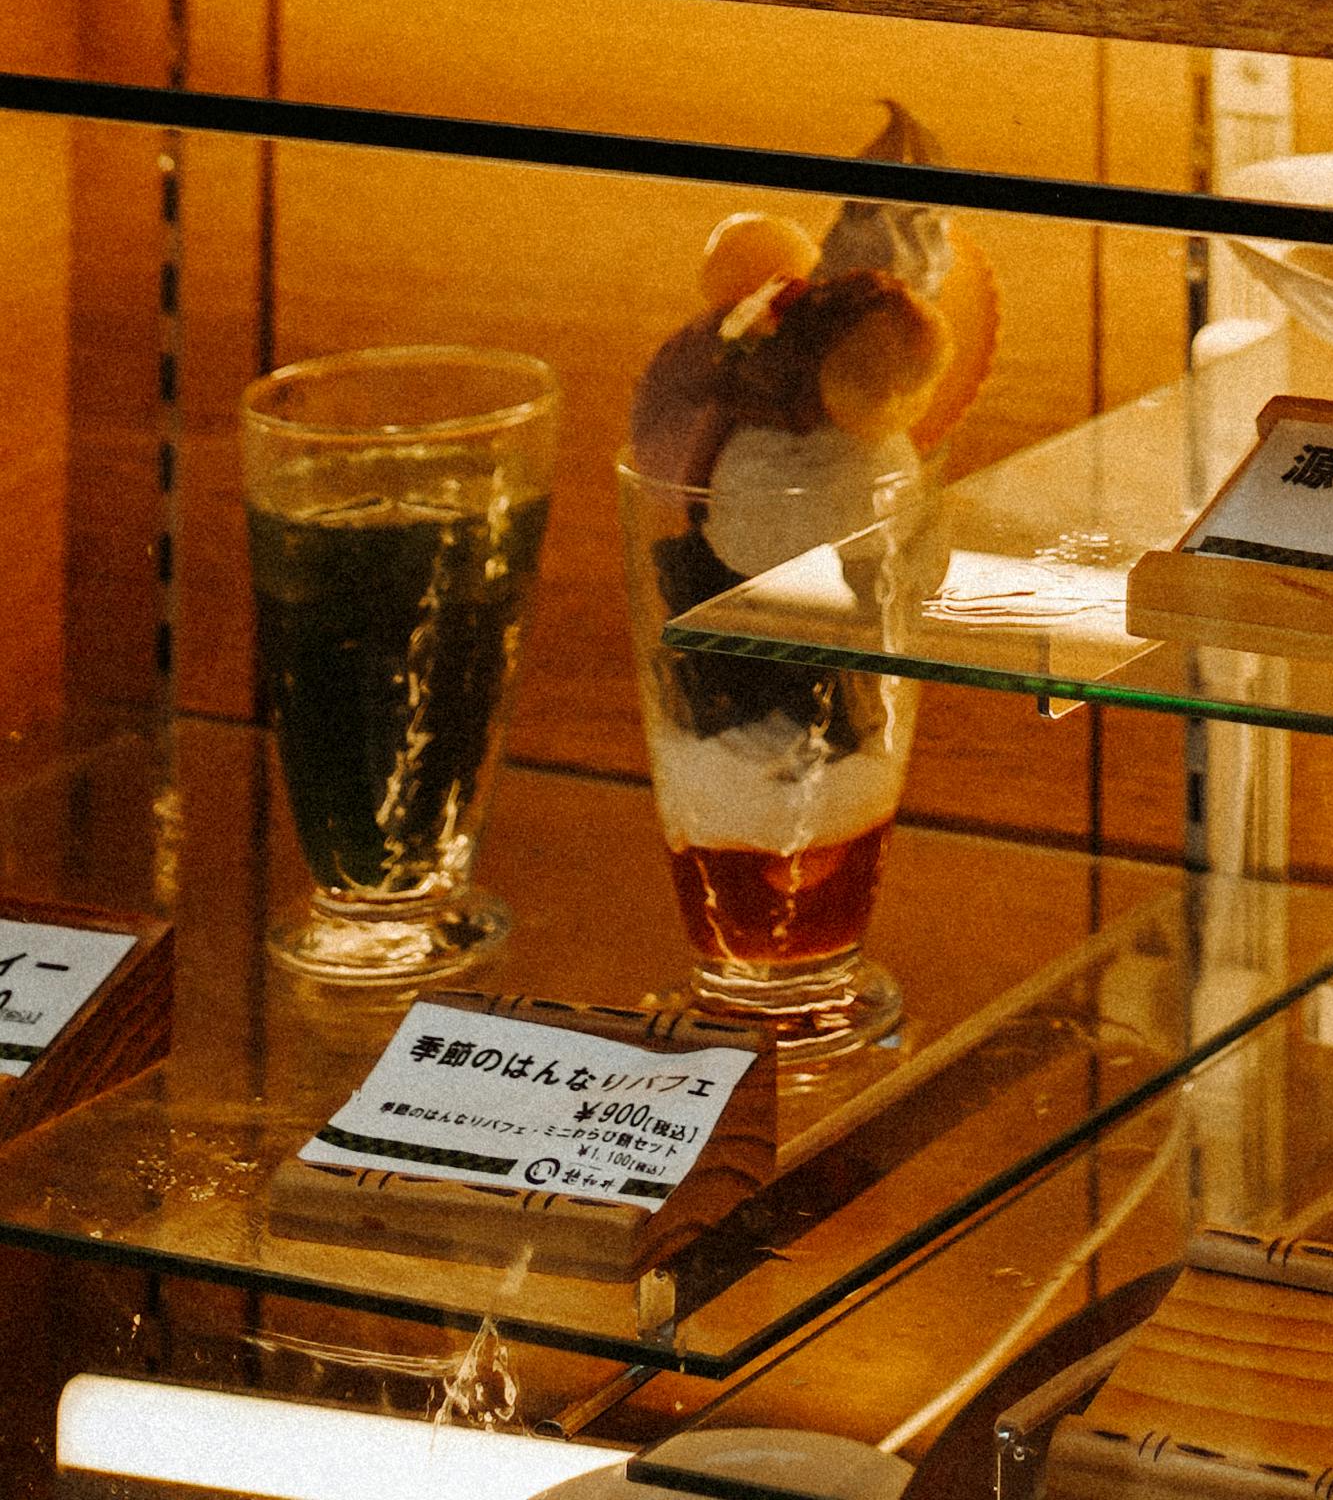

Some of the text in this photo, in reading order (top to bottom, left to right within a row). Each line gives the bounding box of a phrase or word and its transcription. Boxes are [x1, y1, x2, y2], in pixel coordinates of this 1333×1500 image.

[410, 1034, 716, 1098] 季節のはんなりパフェ
